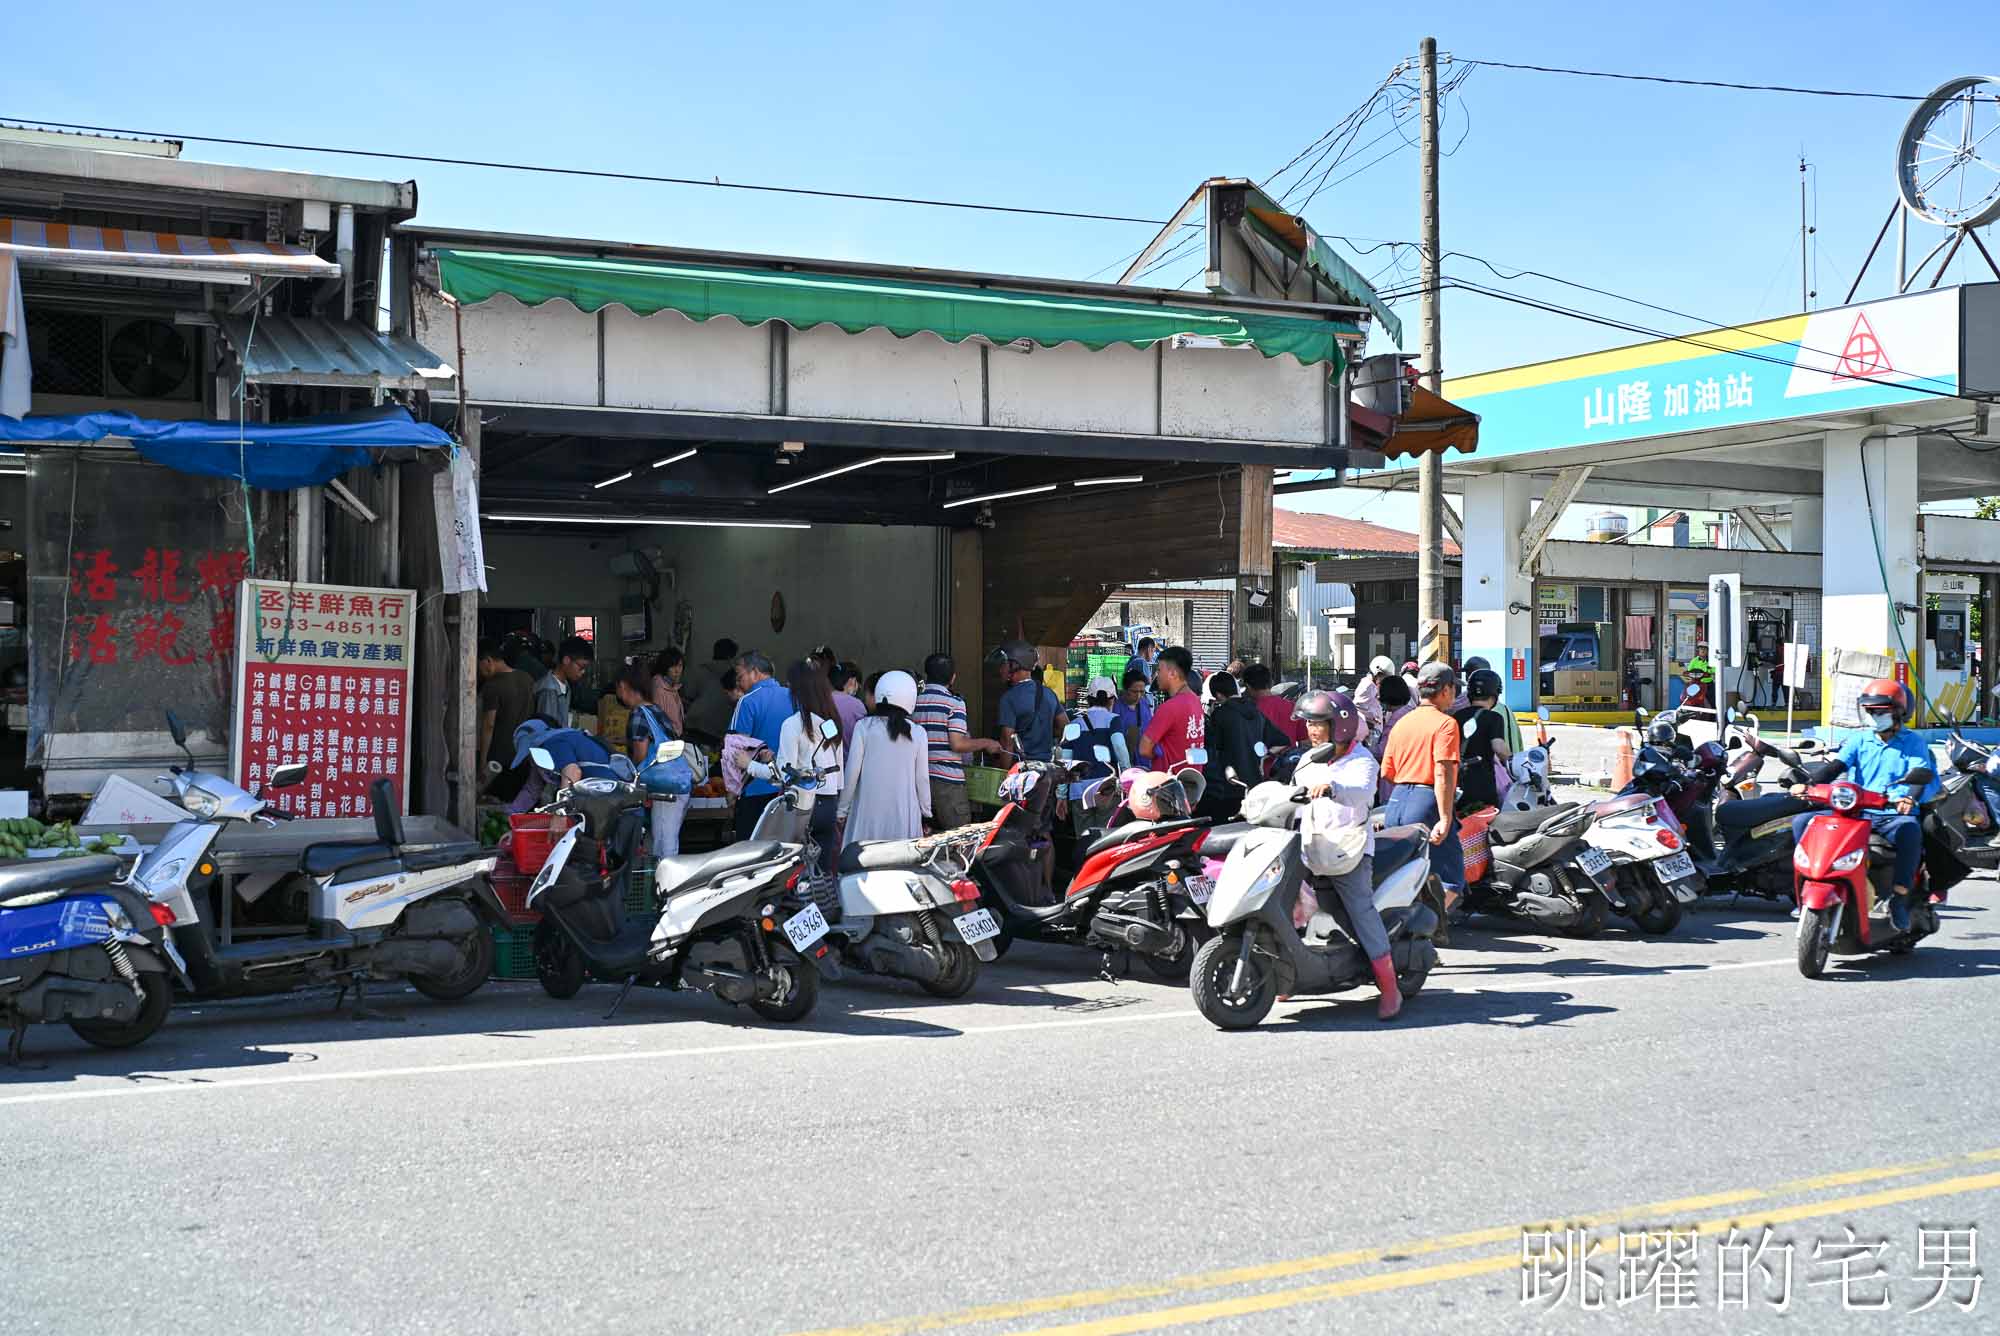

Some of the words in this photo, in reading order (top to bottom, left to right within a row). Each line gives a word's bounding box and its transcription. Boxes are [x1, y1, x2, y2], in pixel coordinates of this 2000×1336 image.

[1584, 380, 1652, 430] 山隆
[1664, 371, 1753, 417] 加油站
[255, 637, 403, 662] 新鮮魚貨海產類
[789, 911, 823, 945] PGL-9669
